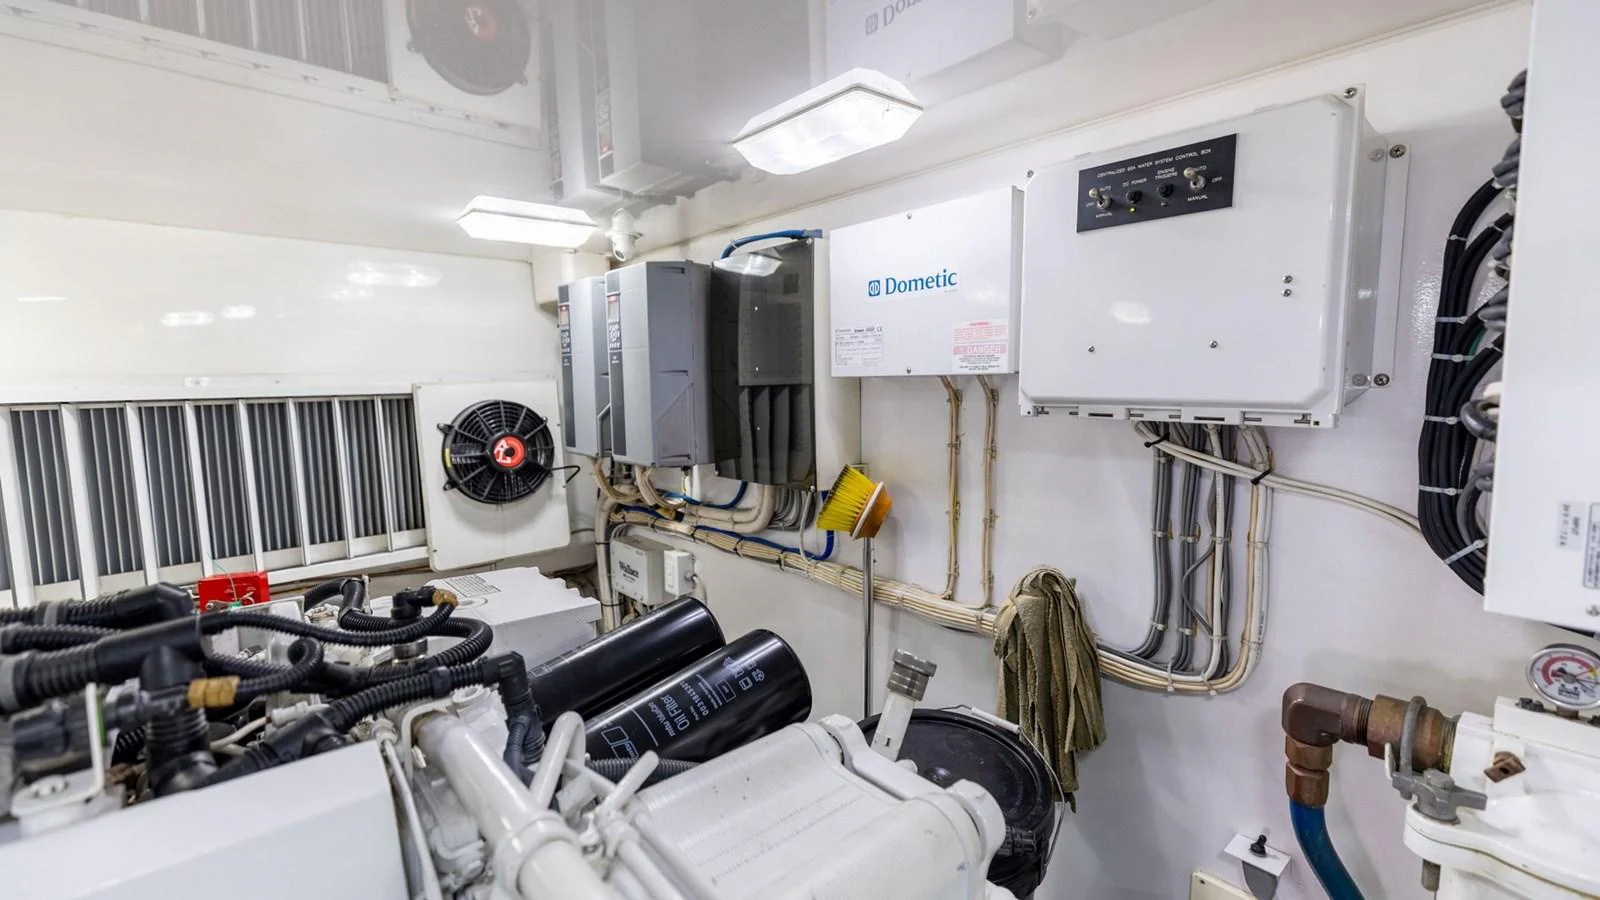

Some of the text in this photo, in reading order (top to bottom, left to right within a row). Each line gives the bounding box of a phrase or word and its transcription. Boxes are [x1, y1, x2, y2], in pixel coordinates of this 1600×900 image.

[1137, 162, 1153, 170] WATER
[1155, 157, 1173, 166] SYSTEM
[1175, 153, 1198, 162] CONTROL
[1200, 148, 1211, 156] BOX
[1131, 177, 1147, 186] POWER
[1188, 194, 1208, 202] MANUAL
[885, 268, 958, 295] Dometic
[967, 344, 1001, 354] DANGER
[660, 694, 690, 731] Oil Filter
[662, 720, 676, 737] mtu
